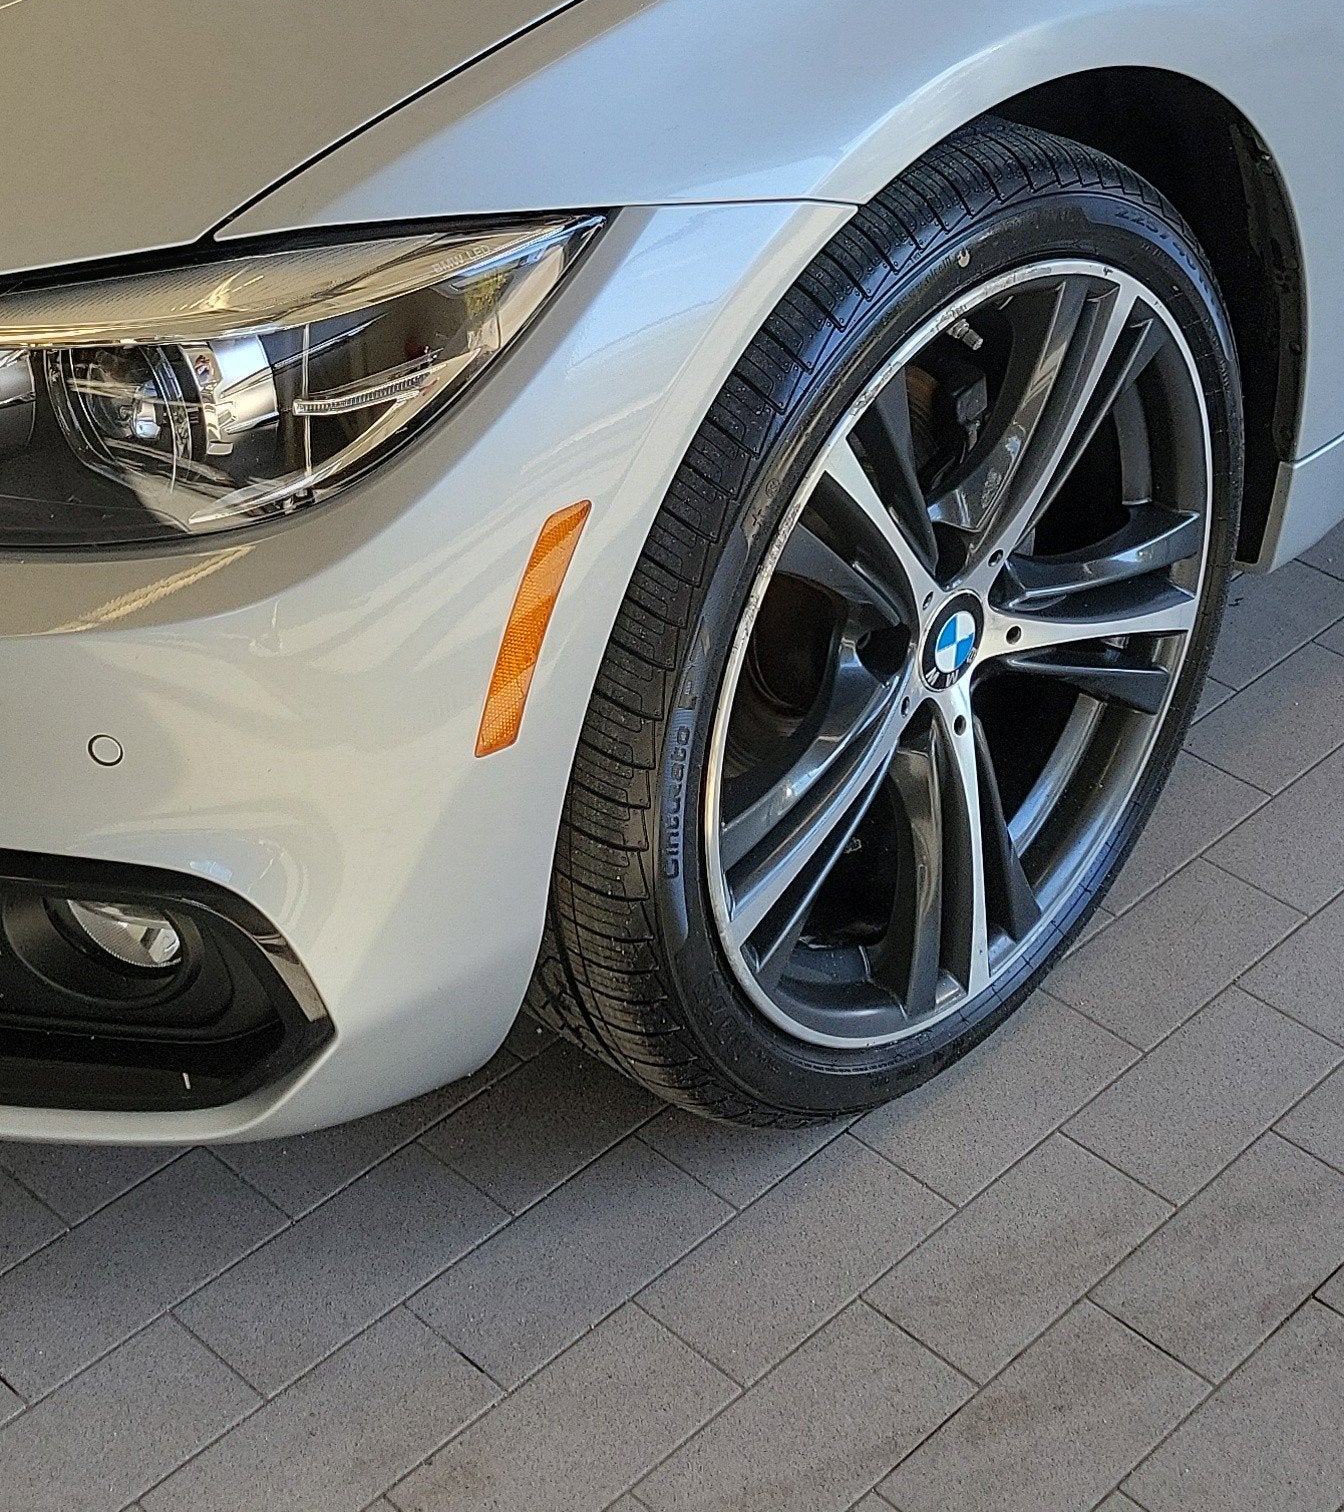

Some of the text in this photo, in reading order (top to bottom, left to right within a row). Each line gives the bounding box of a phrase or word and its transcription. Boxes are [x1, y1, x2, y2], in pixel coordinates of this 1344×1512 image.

[433, 245, 490, 273] BMW LED
[662, 725, 690, 879] Cinturato
